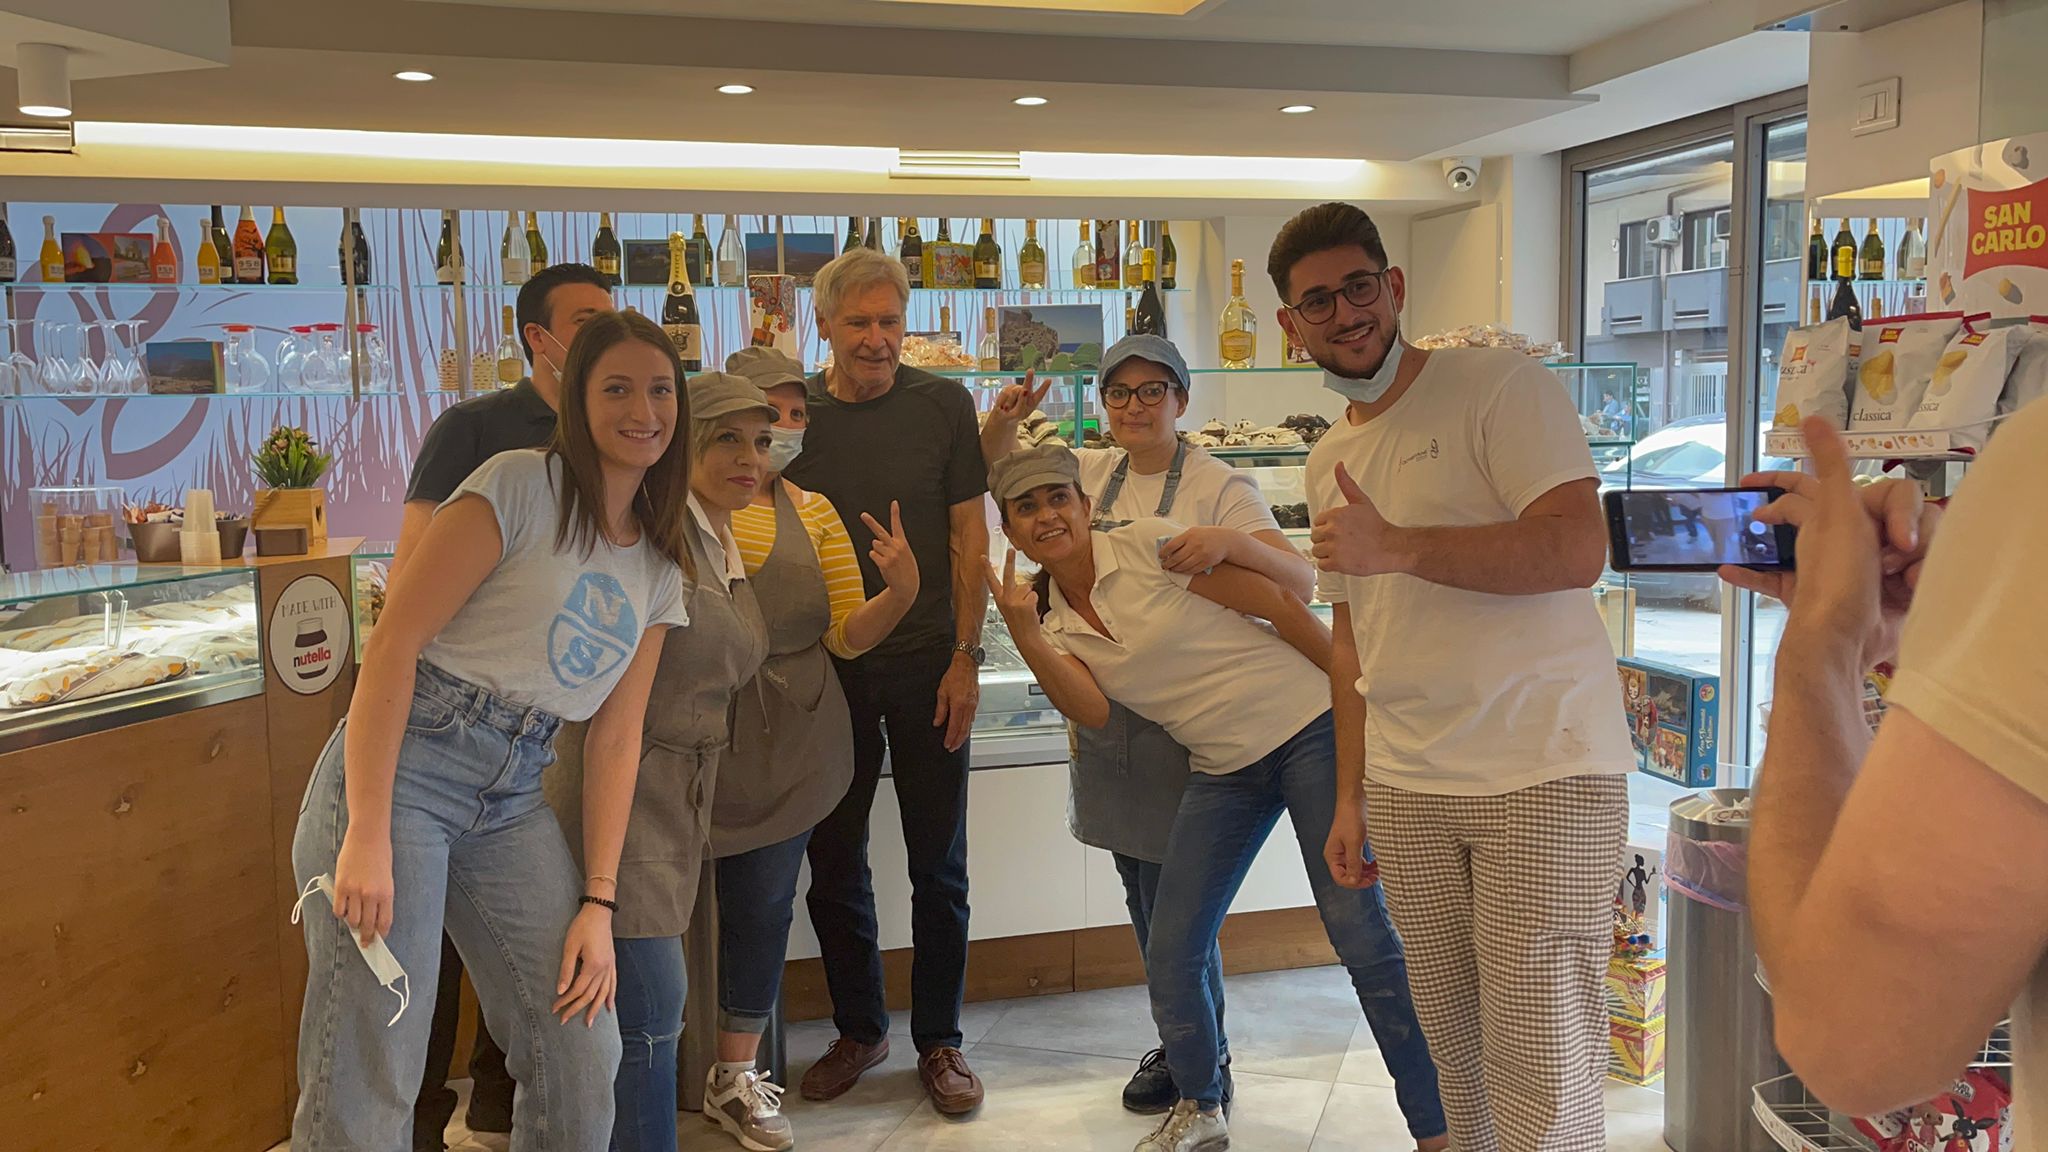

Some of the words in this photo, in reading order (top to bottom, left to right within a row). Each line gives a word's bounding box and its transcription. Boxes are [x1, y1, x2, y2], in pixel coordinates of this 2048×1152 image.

[1984, 200, 2031, 229] SAN
[1971, 224, 2046, 256] CARLO
[1853, 408, 1892, 422] classica
[281, 601, 309, 618] MADE
[313, 596, 337, 611] WITH
[293, 646, 332, 668] nutella
